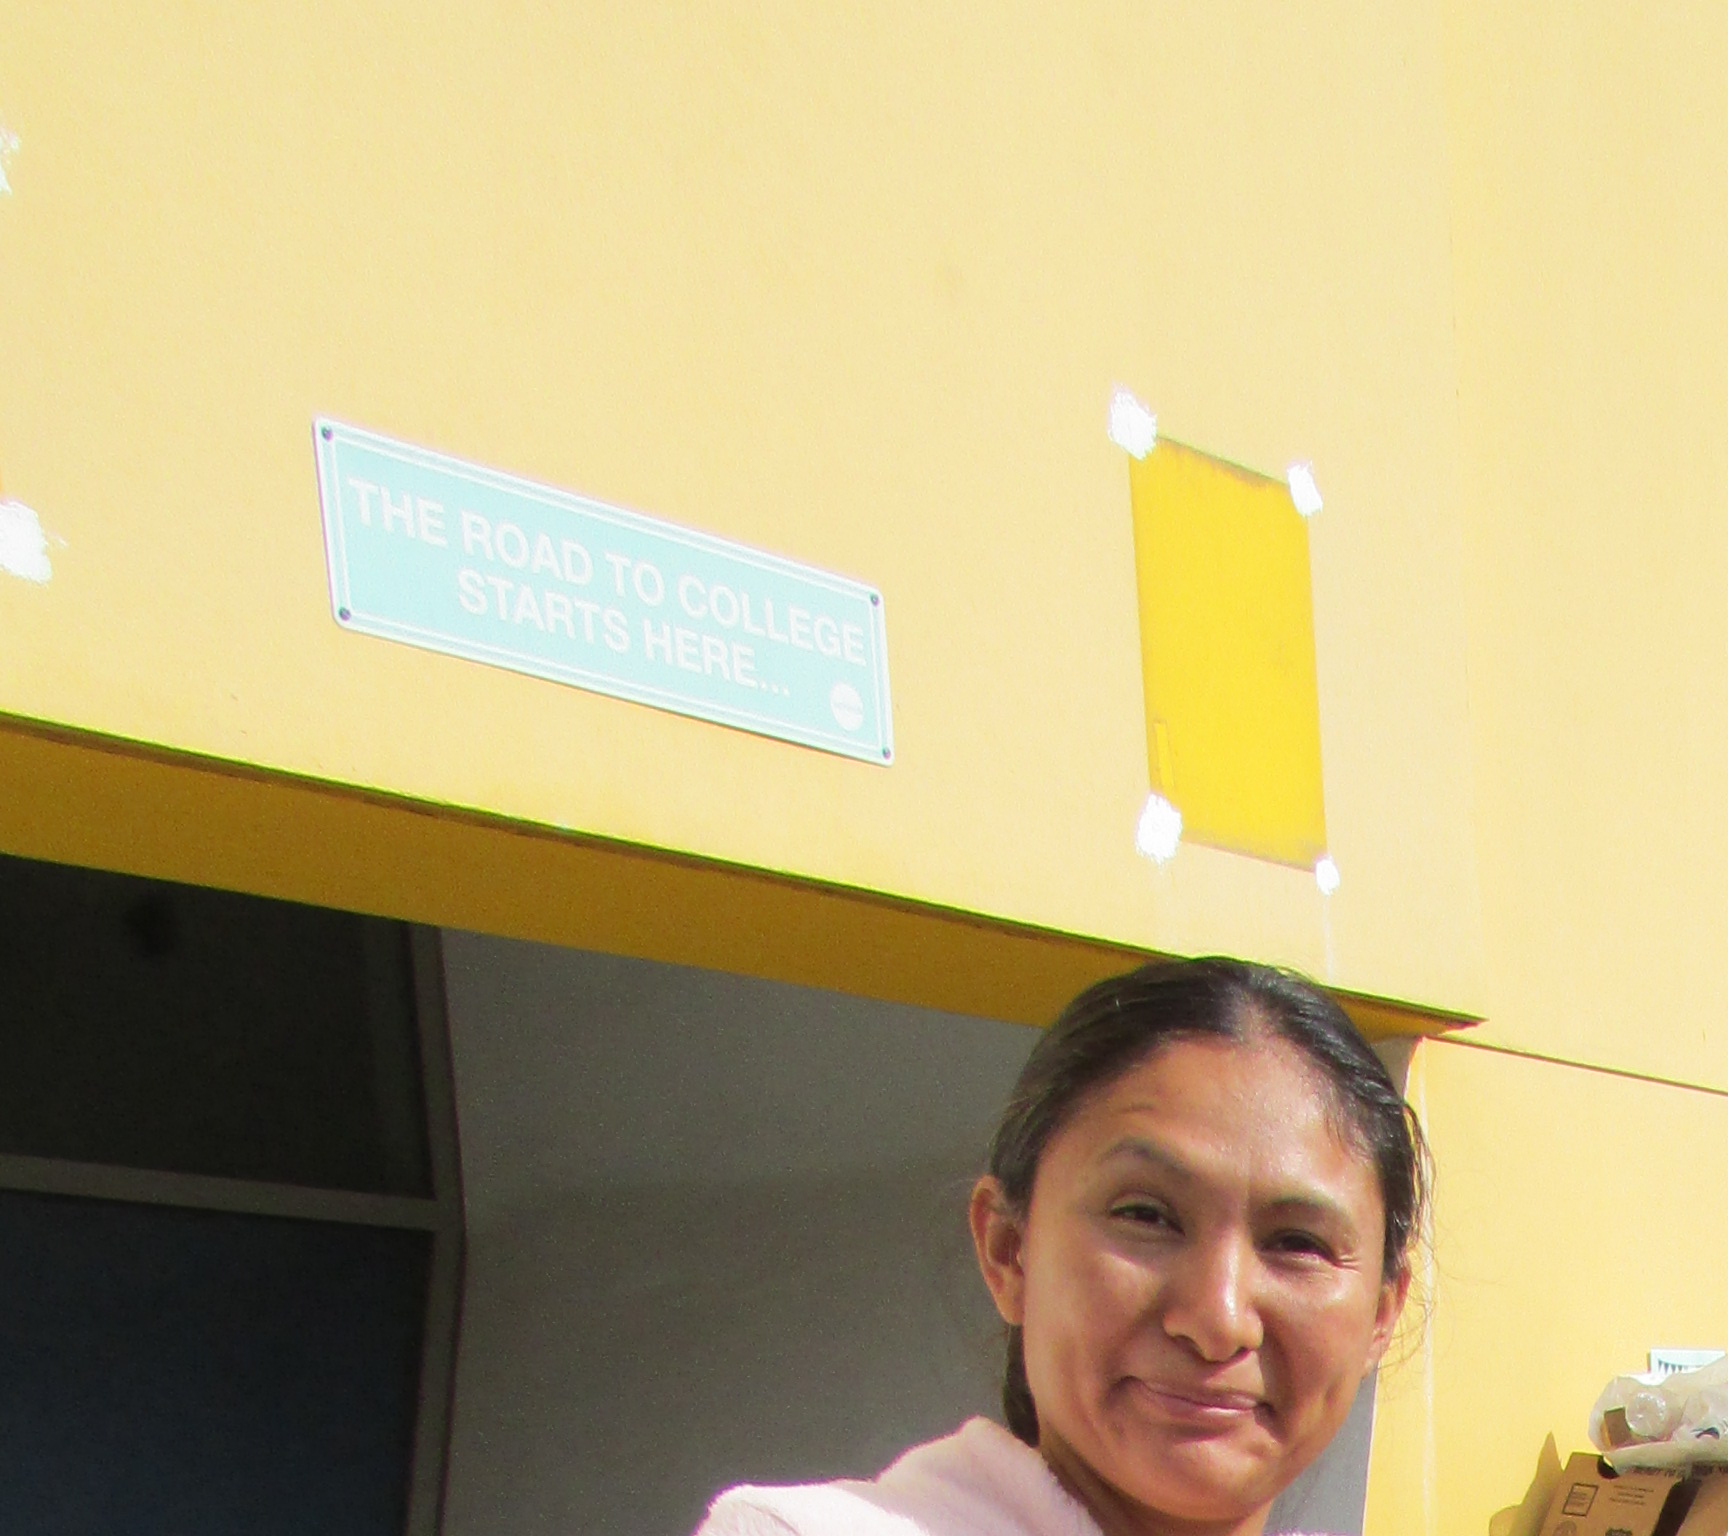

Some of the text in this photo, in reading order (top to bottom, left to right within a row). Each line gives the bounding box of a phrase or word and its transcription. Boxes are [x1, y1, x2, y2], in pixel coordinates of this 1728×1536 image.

[347, 477, 866, 667] THE ROAD TO COLLEGE
[458, 568, 790, 698] STARTS HERE...
